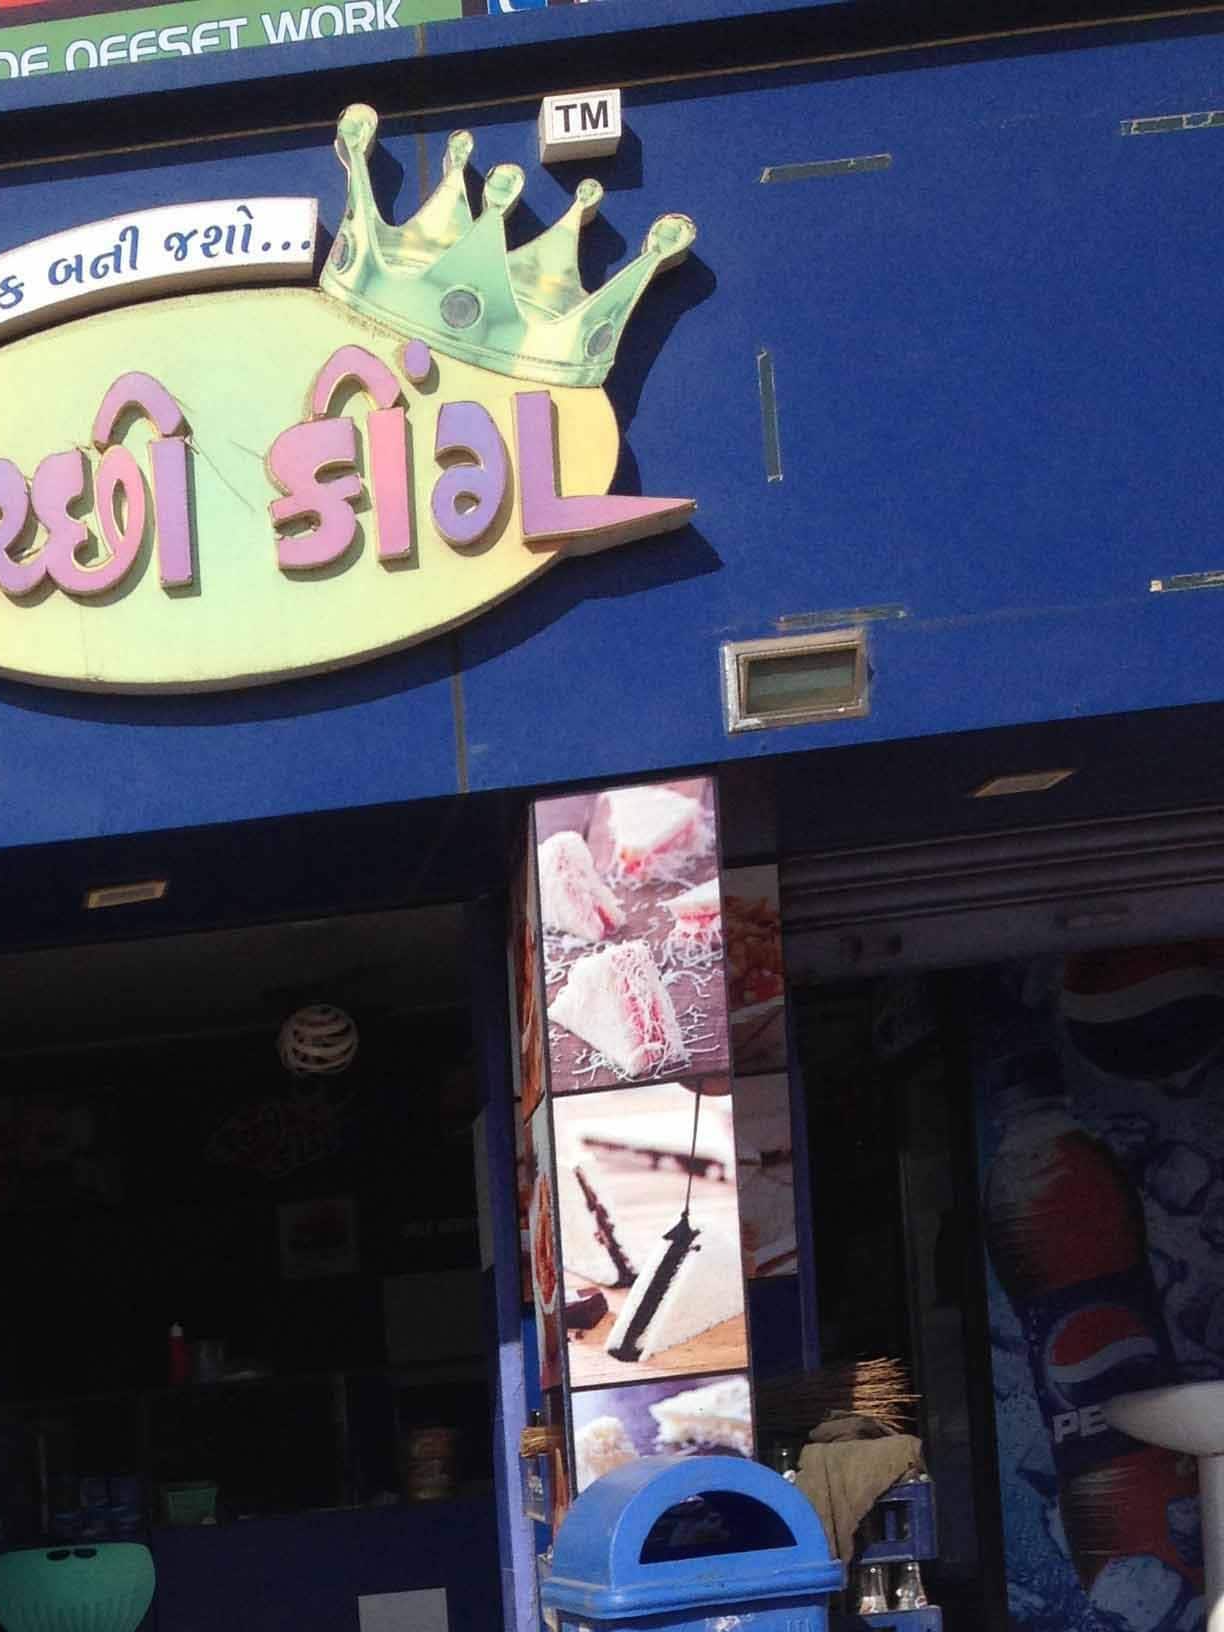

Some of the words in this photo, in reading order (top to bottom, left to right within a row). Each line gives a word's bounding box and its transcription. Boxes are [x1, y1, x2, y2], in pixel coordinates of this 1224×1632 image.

[65, 17, 249, 73] OFFSET
[261, 0, 401, 45] WORK
[554, 101, 610, 133] TM
[47, 226, 140, 287] બની
